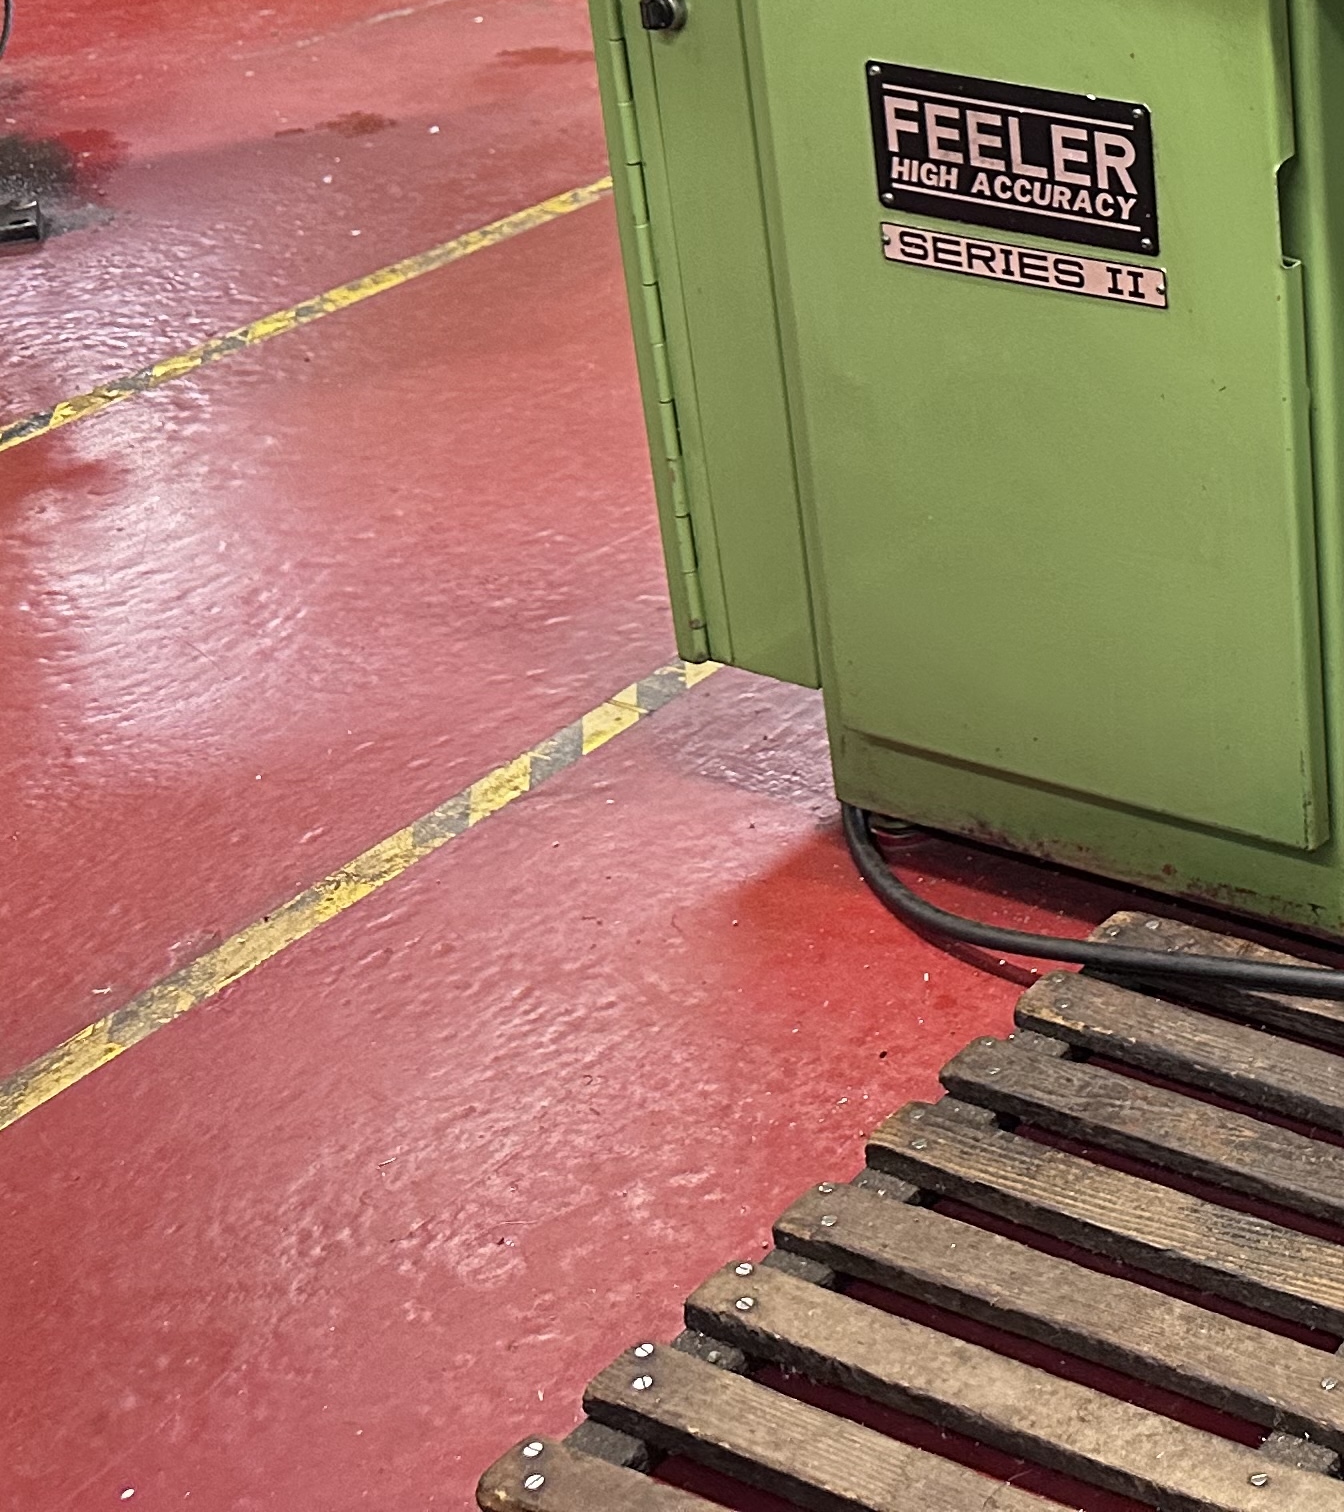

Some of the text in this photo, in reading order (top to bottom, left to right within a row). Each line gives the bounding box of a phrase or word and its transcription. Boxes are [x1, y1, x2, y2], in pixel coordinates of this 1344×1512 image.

[883, 95, 1138, 195] FEELER
[891, 156, 1137, 220] HIGH ACCURACY
[900, 231, 1146, 300] SERIES II
